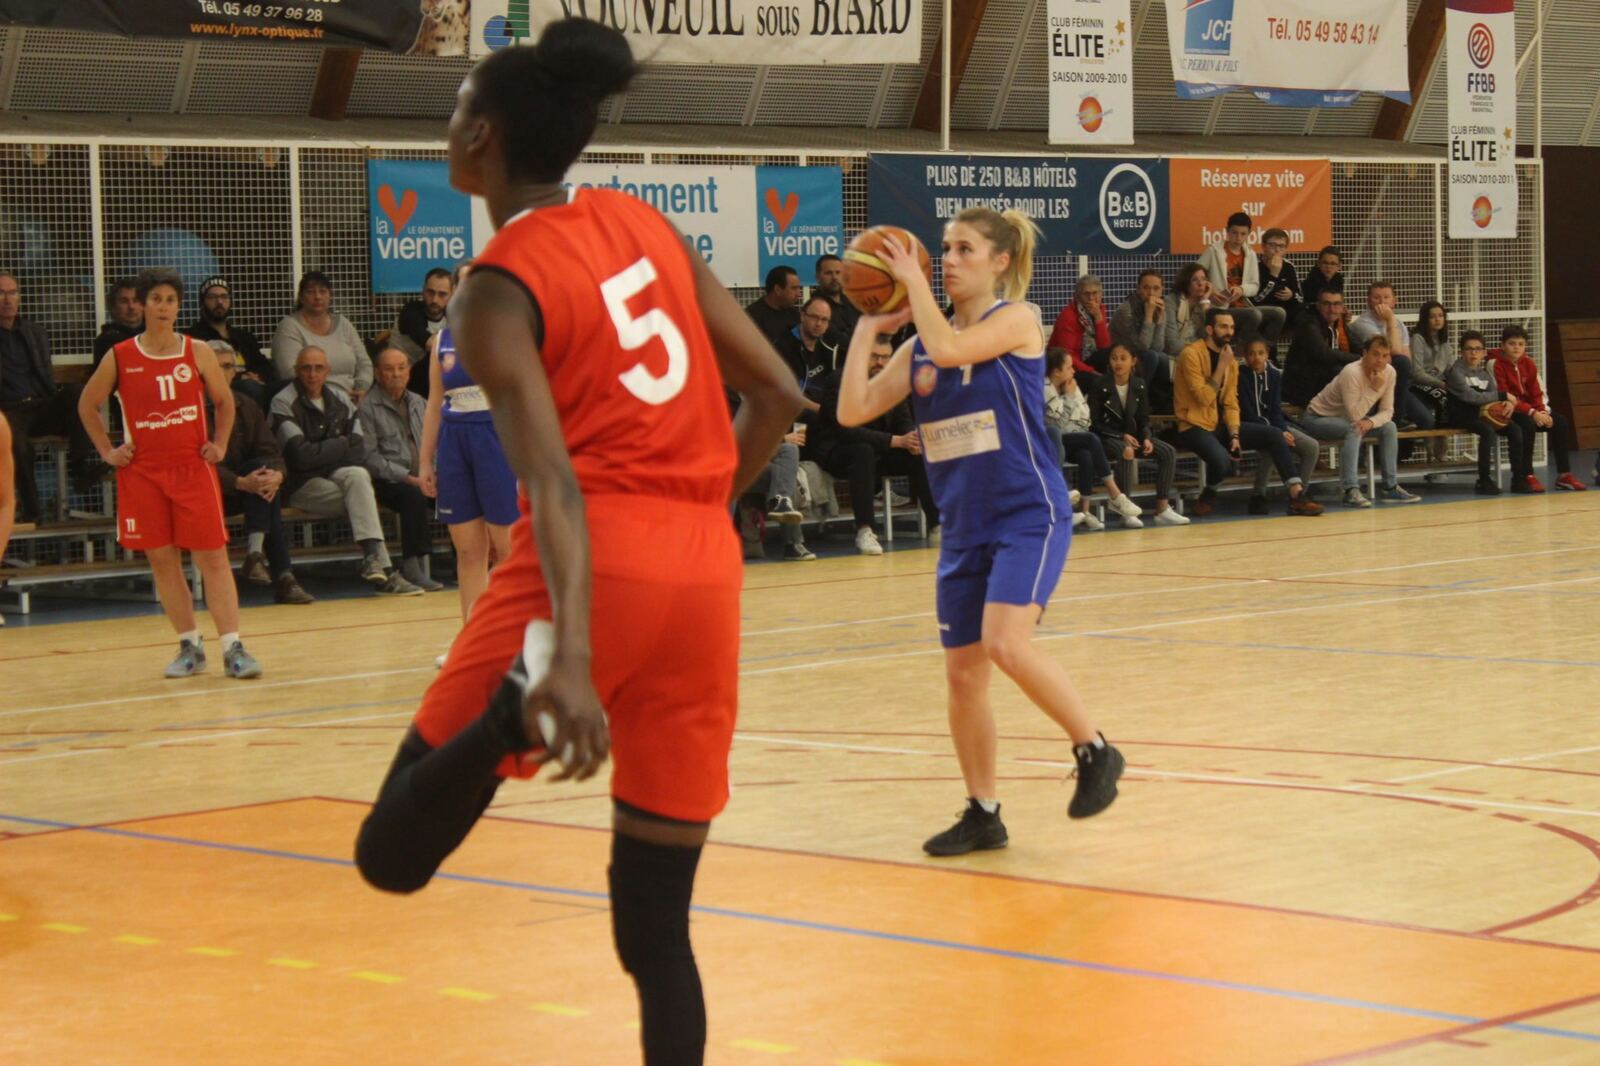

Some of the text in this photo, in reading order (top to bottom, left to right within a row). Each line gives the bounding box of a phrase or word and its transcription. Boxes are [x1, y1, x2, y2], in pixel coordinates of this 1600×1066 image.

[199, 0, 323, 22] Tél. 05 49 37 96 28
[756, 5, 800, 36] sous
[190, 22, 324, 39] www.lynx-optique.fr
[1051, 16, 1104, 28] CLUB FÉMININ
[1267, 17, 1292, 40] Tél.
[1296, 19, 1312, 42] 05
[1314, 20, 1331, 43] 49
[1333, 22, 1349, 44] 58
[1350, 23, 1366, 45] 43
[1052, 29, 1105, 58] ÉLITE
[1052, 71, 1128, 84] SAISON 2009-2010
[1467, 72, 1496, 94] FFBB
[1451, 125, 1496, 136] CLUB FÉMININ
[1452, 135, 1497, 162] ÉLITE
[926, 161, 1077, 188] PLUS DE 250 B&B HÔTELS
[1200, 168, 1305, 188] Réservez vite
[1451, 174, 1514, 185] SAISON 2010-2011
[935, 197, 963, 218] BIEN
[1048, 198, 1070, 219] LES
[1107, 191, 1150, 217] B&B
[1241, 200, 1266, 216] sur
[375, 216, 389, 235] la
[407, 224, 464, 235] LE DÉPARTEMENT
[763, 217, 775, 234] la
[1113, 218, 1144, 229] HOTELS
[376, 236, 465, 260] vienne
[764, 235, 839, 256] vienne
[599, 255, 689, 406] 5
[156, 374, 176, 401] 11
[126, 518, 136, 532] 11
